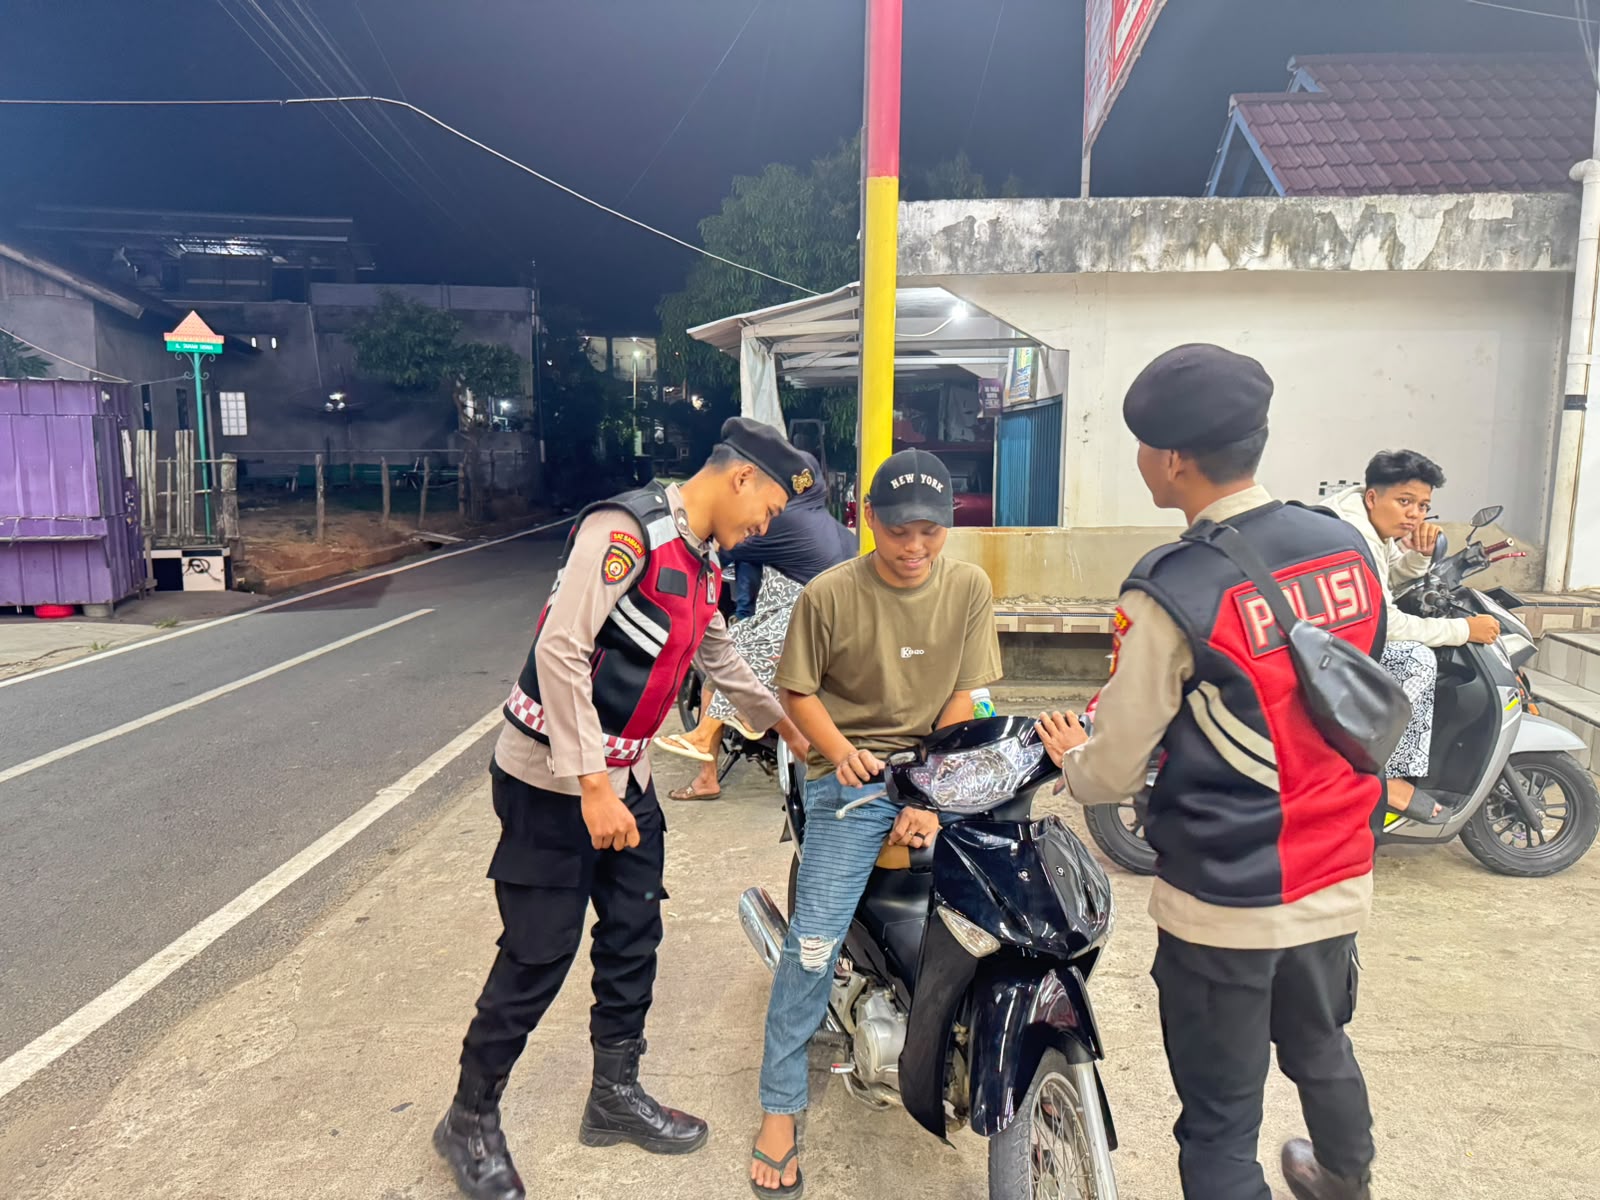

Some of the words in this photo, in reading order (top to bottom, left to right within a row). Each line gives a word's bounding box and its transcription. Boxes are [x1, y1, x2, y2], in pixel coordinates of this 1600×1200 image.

[890, 473, 915, 490] NEW
[920, 473, 944, 493] YORK
[1244, 565, 1370, 649] PLISI
